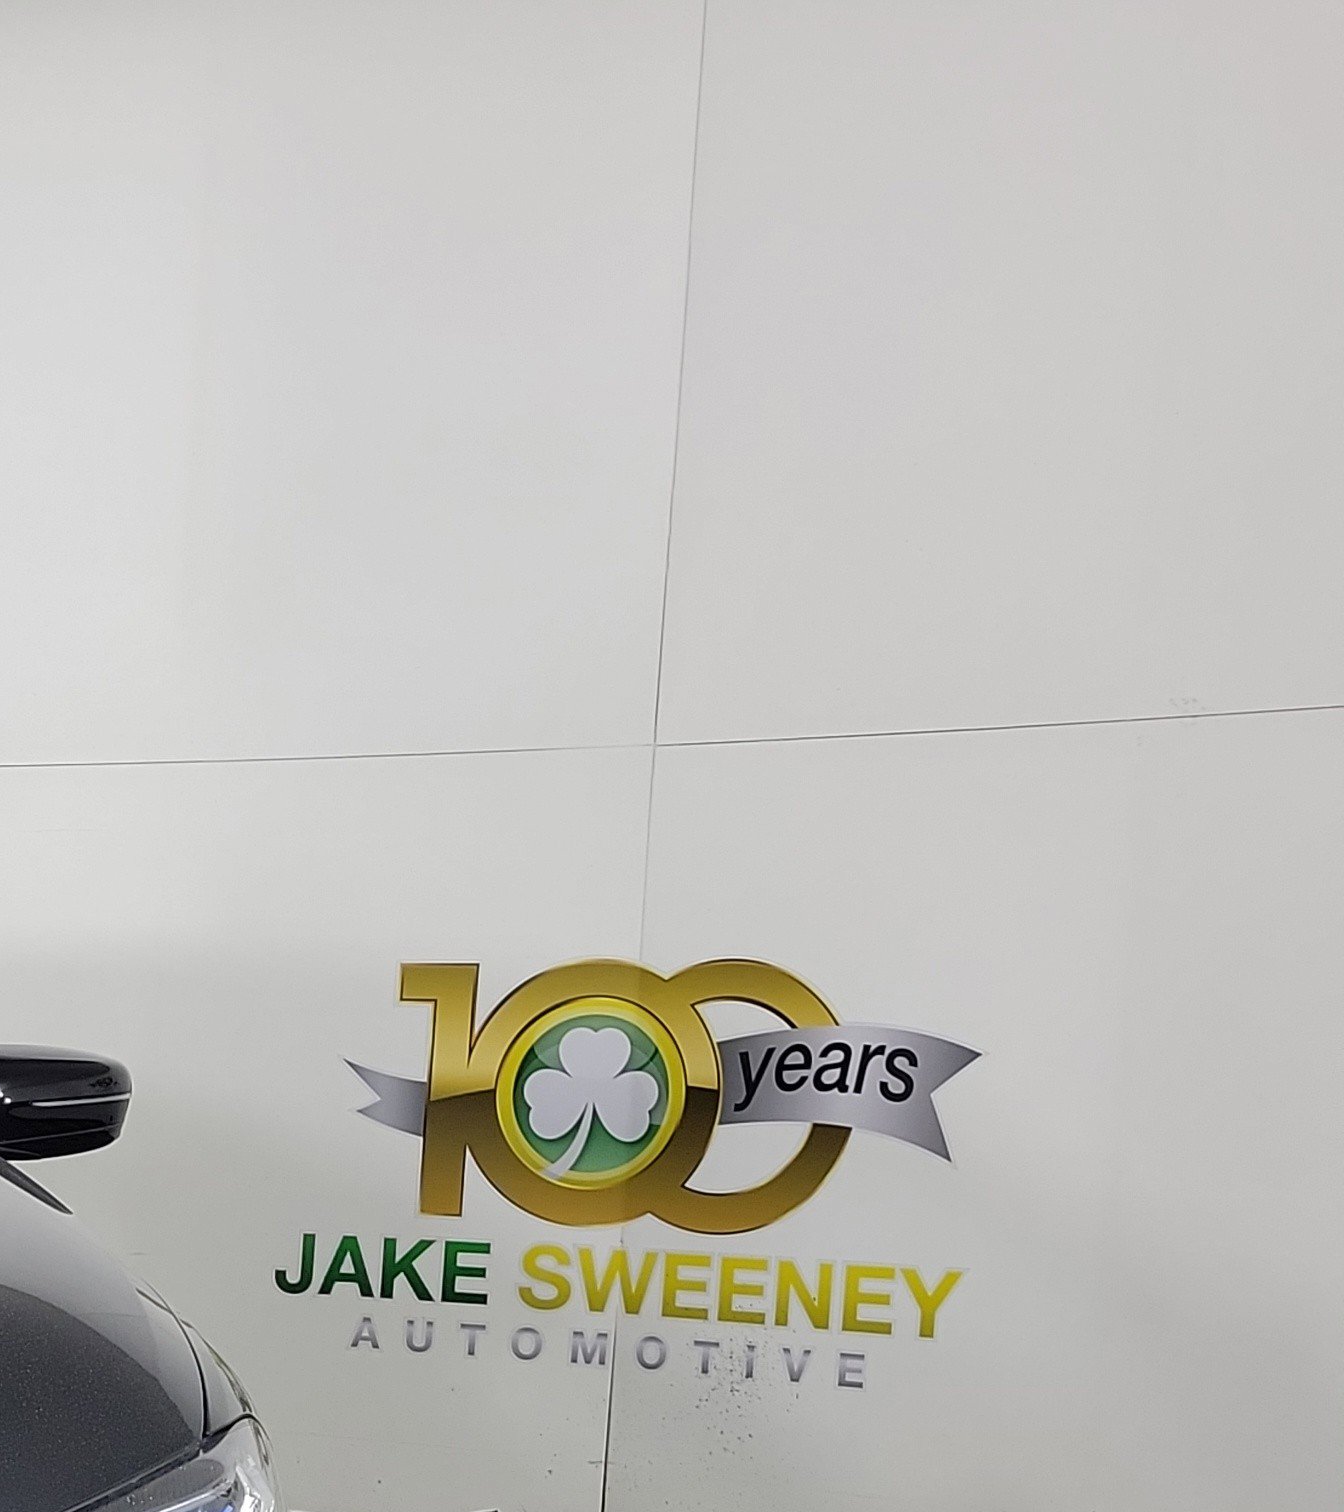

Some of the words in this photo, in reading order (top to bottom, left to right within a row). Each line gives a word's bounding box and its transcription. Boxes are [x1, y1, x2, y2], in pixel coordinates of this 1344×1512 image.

[399, 958, 853, 1236] 100
[733, 1041, 919, 1113] years
[274, 1233, 492, 1305] JAKE
[518, 1244, 964, 1340] SWEENEY
[350, 1316, 866, 1389] AUTOMOTIVE
